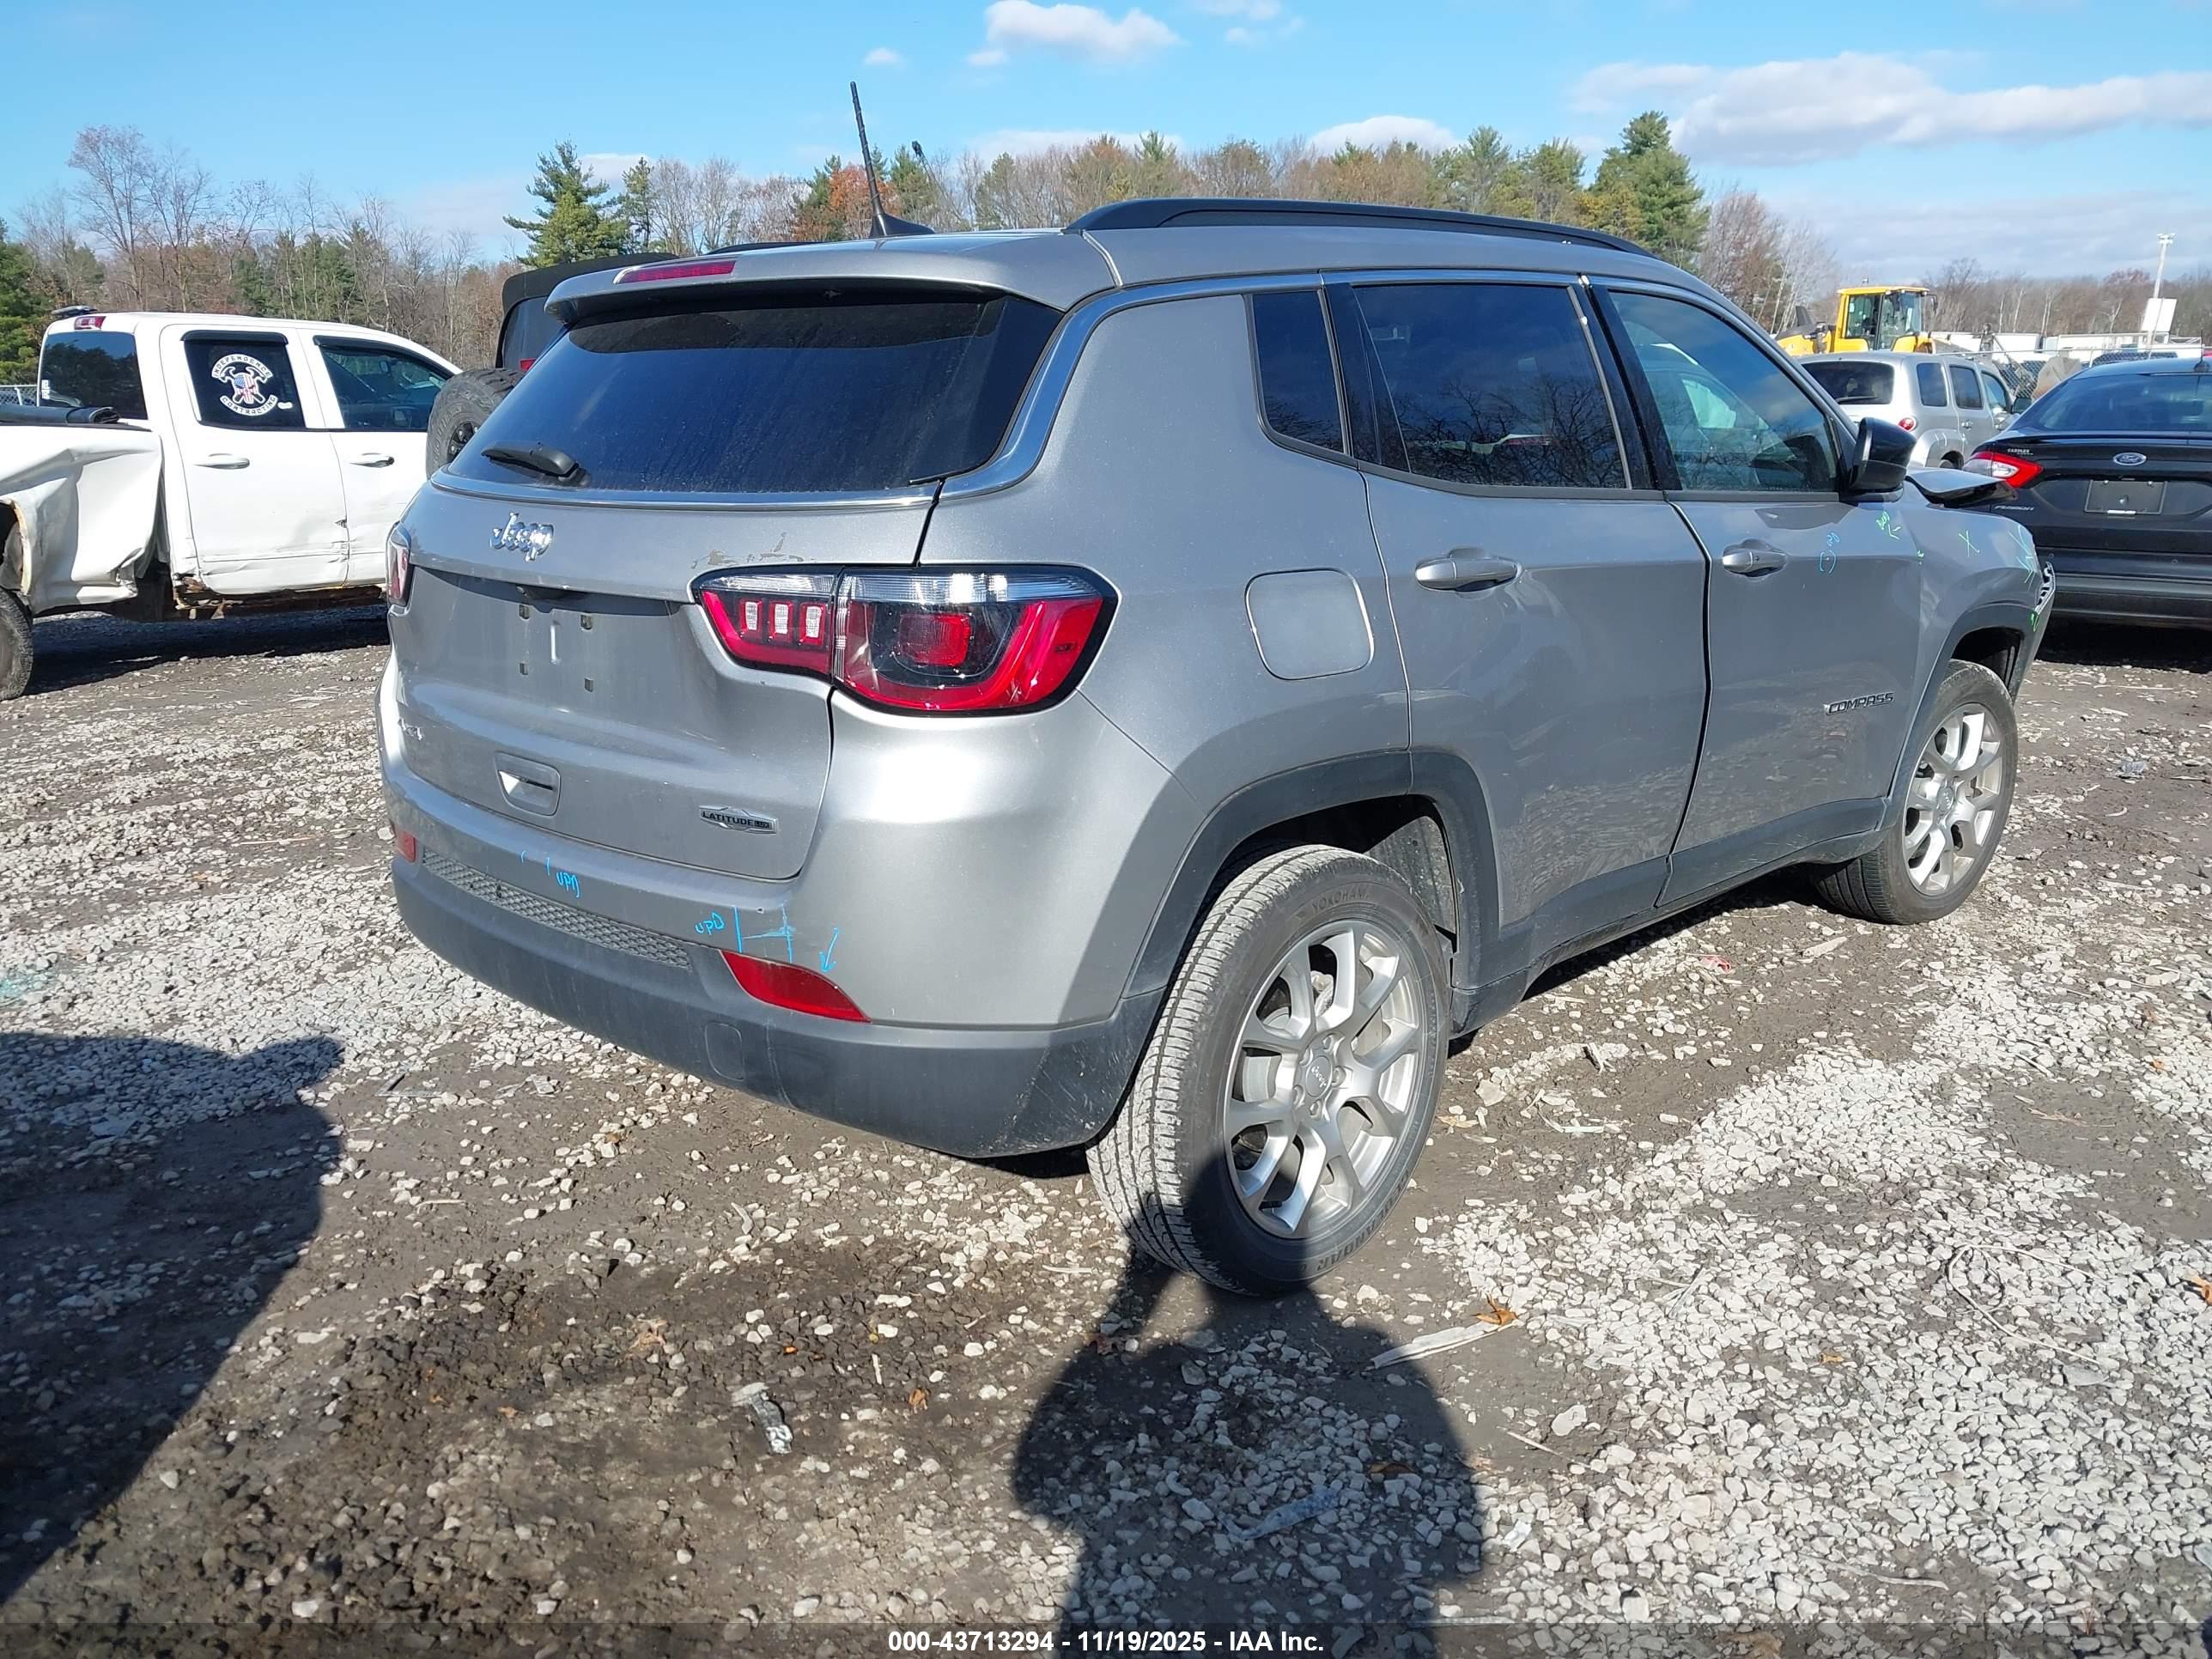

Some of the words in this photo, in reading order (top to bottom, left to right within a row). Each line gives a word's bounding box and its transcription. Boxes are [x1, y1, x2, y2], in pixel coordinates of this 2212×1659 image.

[212, 355, 271, 377] INDEPENDENCE
[222, 396, 276, 415] CONTRACTING
[489, 512, 554, 562] Jeep
[1826, 691, 1894, 715] COMPASS
[702, 811, 754, 826] LATITUDE
